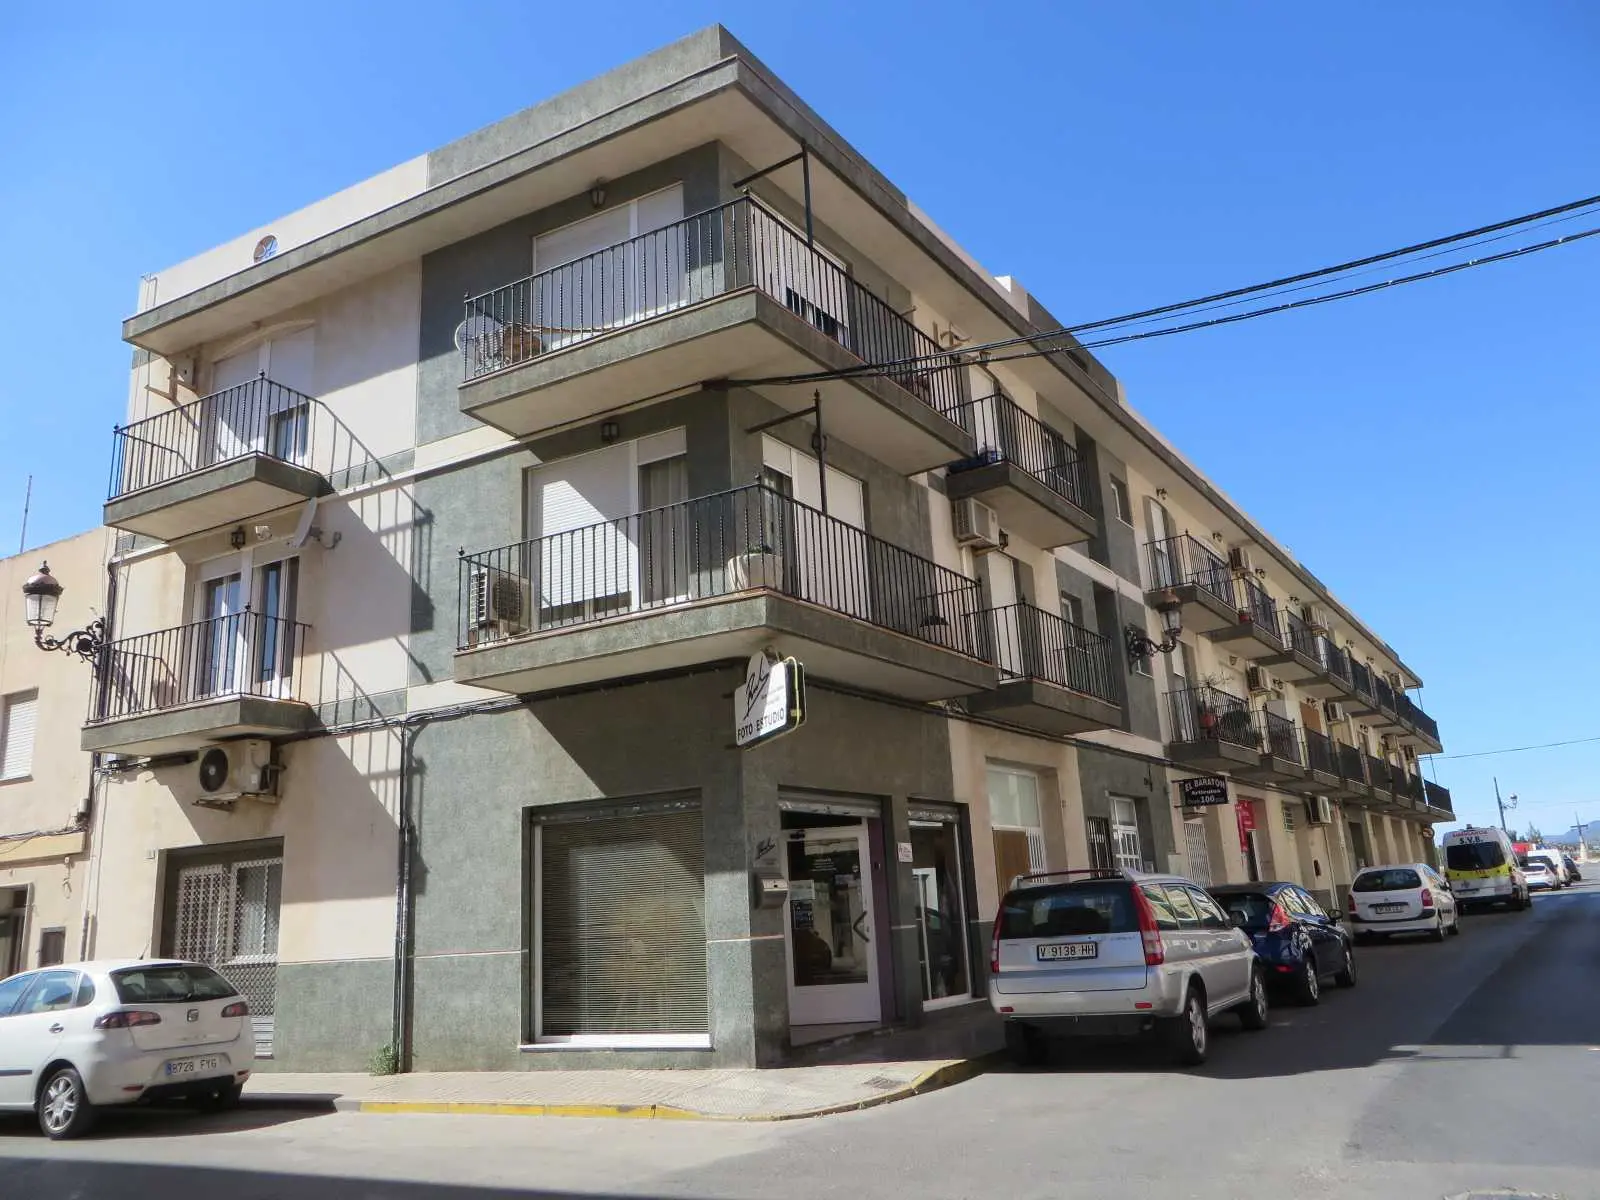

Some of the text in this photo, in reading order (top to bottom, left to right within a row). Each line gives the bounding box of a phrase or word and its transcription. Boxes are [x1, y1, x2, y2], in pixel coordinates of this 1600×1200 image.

[737, 707, 785, 741] FOTO ESTUDIO
[1184, 782, 1193, 792] EL
[1200, 794, 1215, 804] 100
[1040, 944, 1094, 957] V 9138 HH
[172, 1061, 194, 1074] 8728
